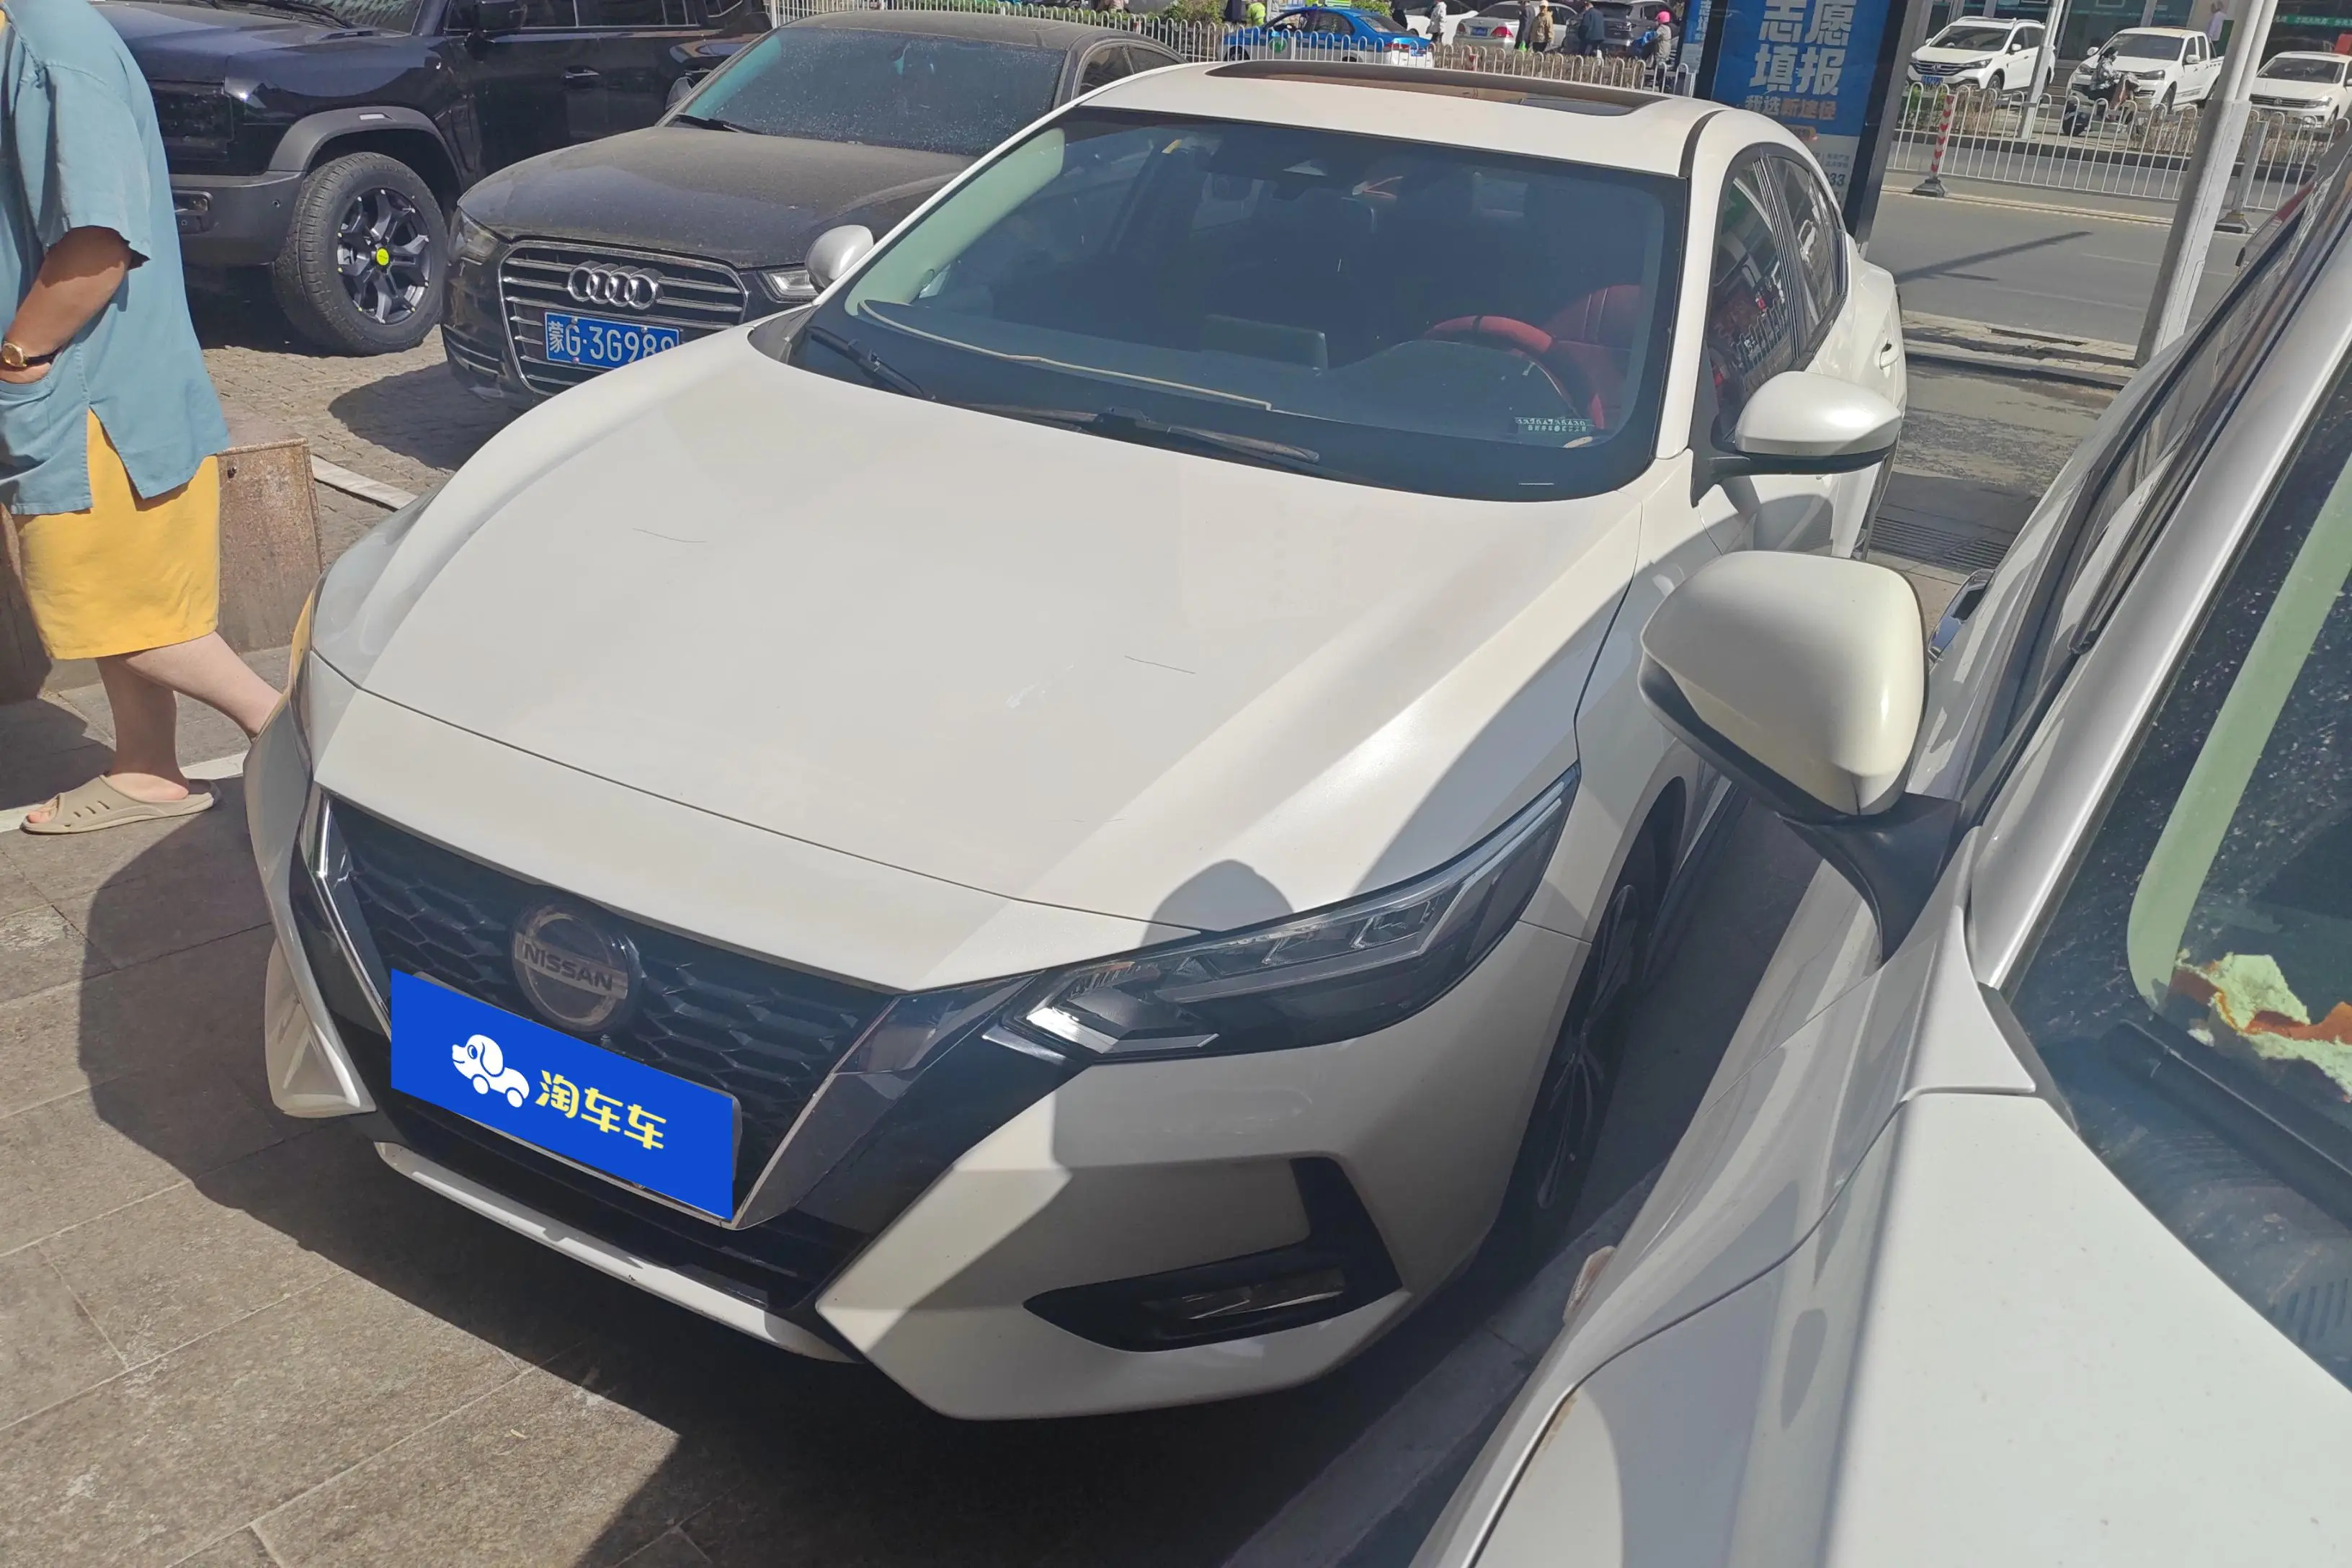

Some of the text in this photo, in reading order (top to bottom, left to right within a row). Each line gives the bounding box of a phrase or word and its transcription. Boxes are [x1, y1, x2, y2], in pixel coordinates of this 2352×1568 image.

[1758, 0, 1856, 45] 志愿
[1749, 43, 1846, 95] 填报
[524, 943, 612, 992] NISSAN
